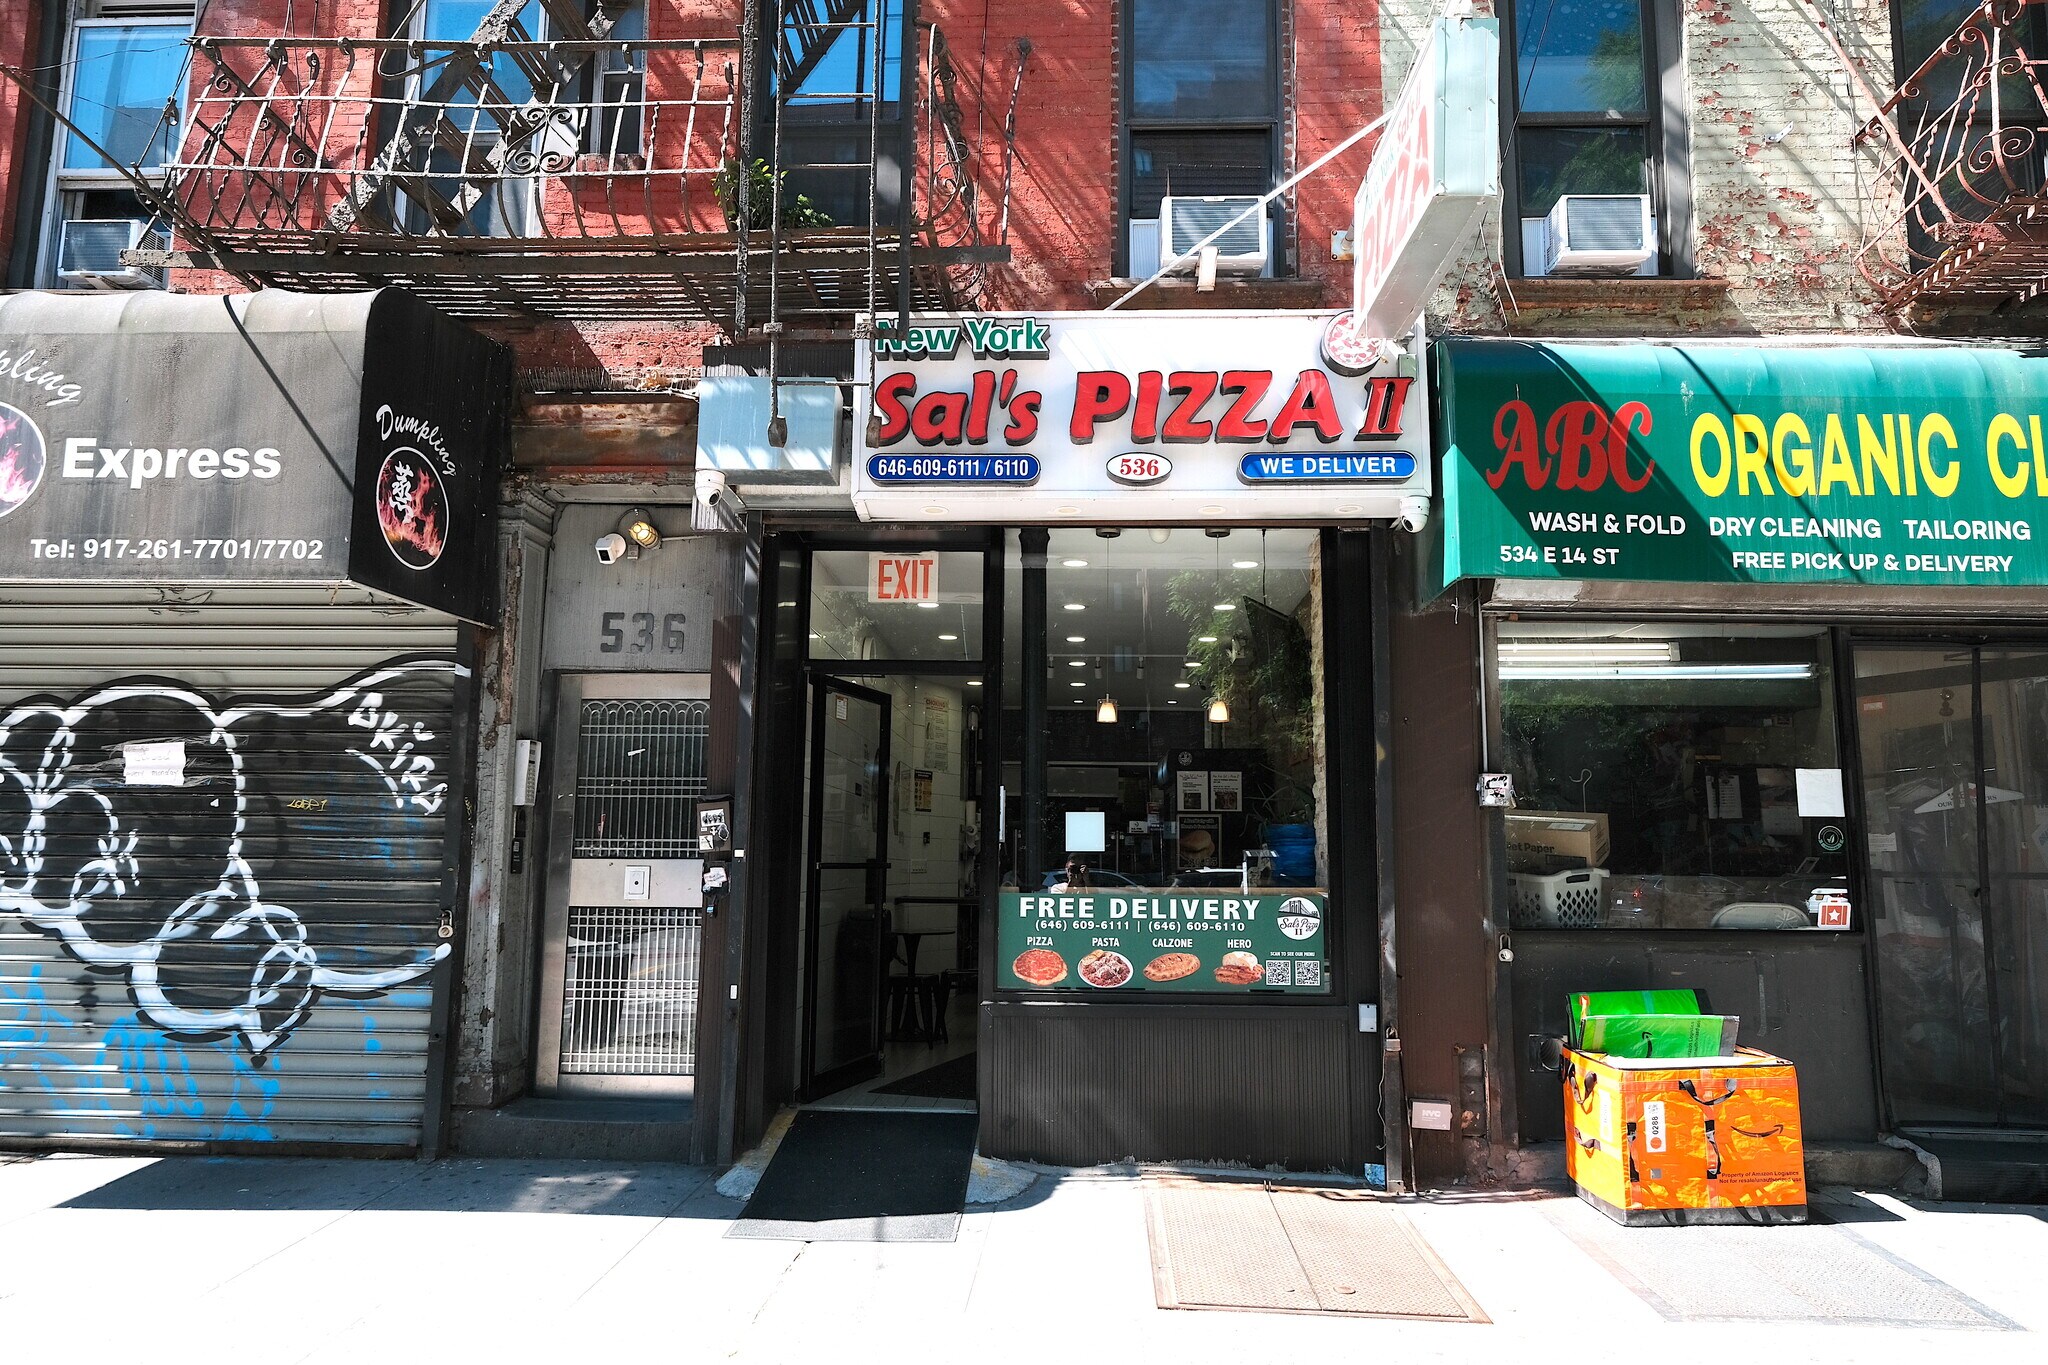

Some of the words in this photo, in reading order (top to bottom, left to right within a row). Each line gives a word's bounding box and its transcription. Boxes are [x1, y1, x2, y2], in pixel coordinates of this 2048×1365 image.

[876, 318, 960, 353] New
[963, 318, 1049, 352] York
[875, 369, 1042, 446] Sal's
[1070, 369, 1344, 444] PIZZA
[1355, 376, 1414, 441] II
[375, 404, 457, 477] Dumpling
[1486, 400, 1655, 494] ABC
[62, 437, 281, 489] Express
[1260, 457, 1294, 474] WE
[1302, 456, 1396, 474] DELIVER
[1689, 412, 1961, 499] ORGANIC
[878, 459, 979, 476] 646-609-6111
[984, 459, 991, 476] /
[994, 459, 1029, 476] 6110
[1119, 458, 1159, 477] 536
[1528, 512, 1597, 533] WASH
[1603, 514, 1620, 534] &
[1626, 515, 1686, 535] FOLD
[1709, 517, 1756, 537] DRY
[1760, 517, 1881, 538] CLEANING
[1903, 519, 2031, 540] TAILORING
[30, 539, 74, 559] Tel:
[83, 539, 324, 559] 917-261-7701/7702
[1500, 545, 1538, 563] 534
[1544, 546, 1556, 563] E
[1562, 547, 1587, 564] 14
[1592, 548, 1619, 565] ST
[1732, 551, 1786, 569] FREE
[1791, 552, 1843, 570] PICK
[1849, 554, 1878, 571] UP
[1883, 553, 1900, 571] &
[1905, 554, 2013, 572] DELIVERY
[878, 559, 933, 599] EXIT
[600, 612, 686, 655] 536
[1524, 842, 1555, 854] Paper
[1020, 897, 1094, 918] FREE
[1110, 898, 1260, 920] DELIVERY
[1035, 920, 1067, 932] (646)
[1072, 920, 1129, 930] 609-6111
[1148, 921, 1181, 933] (646)
[1186, 922, 1245, 931] 609-6110
[1027, 936, 1053, 946] PIZZA
[1092, 937, 1120, 947] PASTA
[1152, 938, 1193, 948] CALZONE
[1227, 939, 1252, 949] HERO
[1422, 1109, 1441, 1118] NYC
